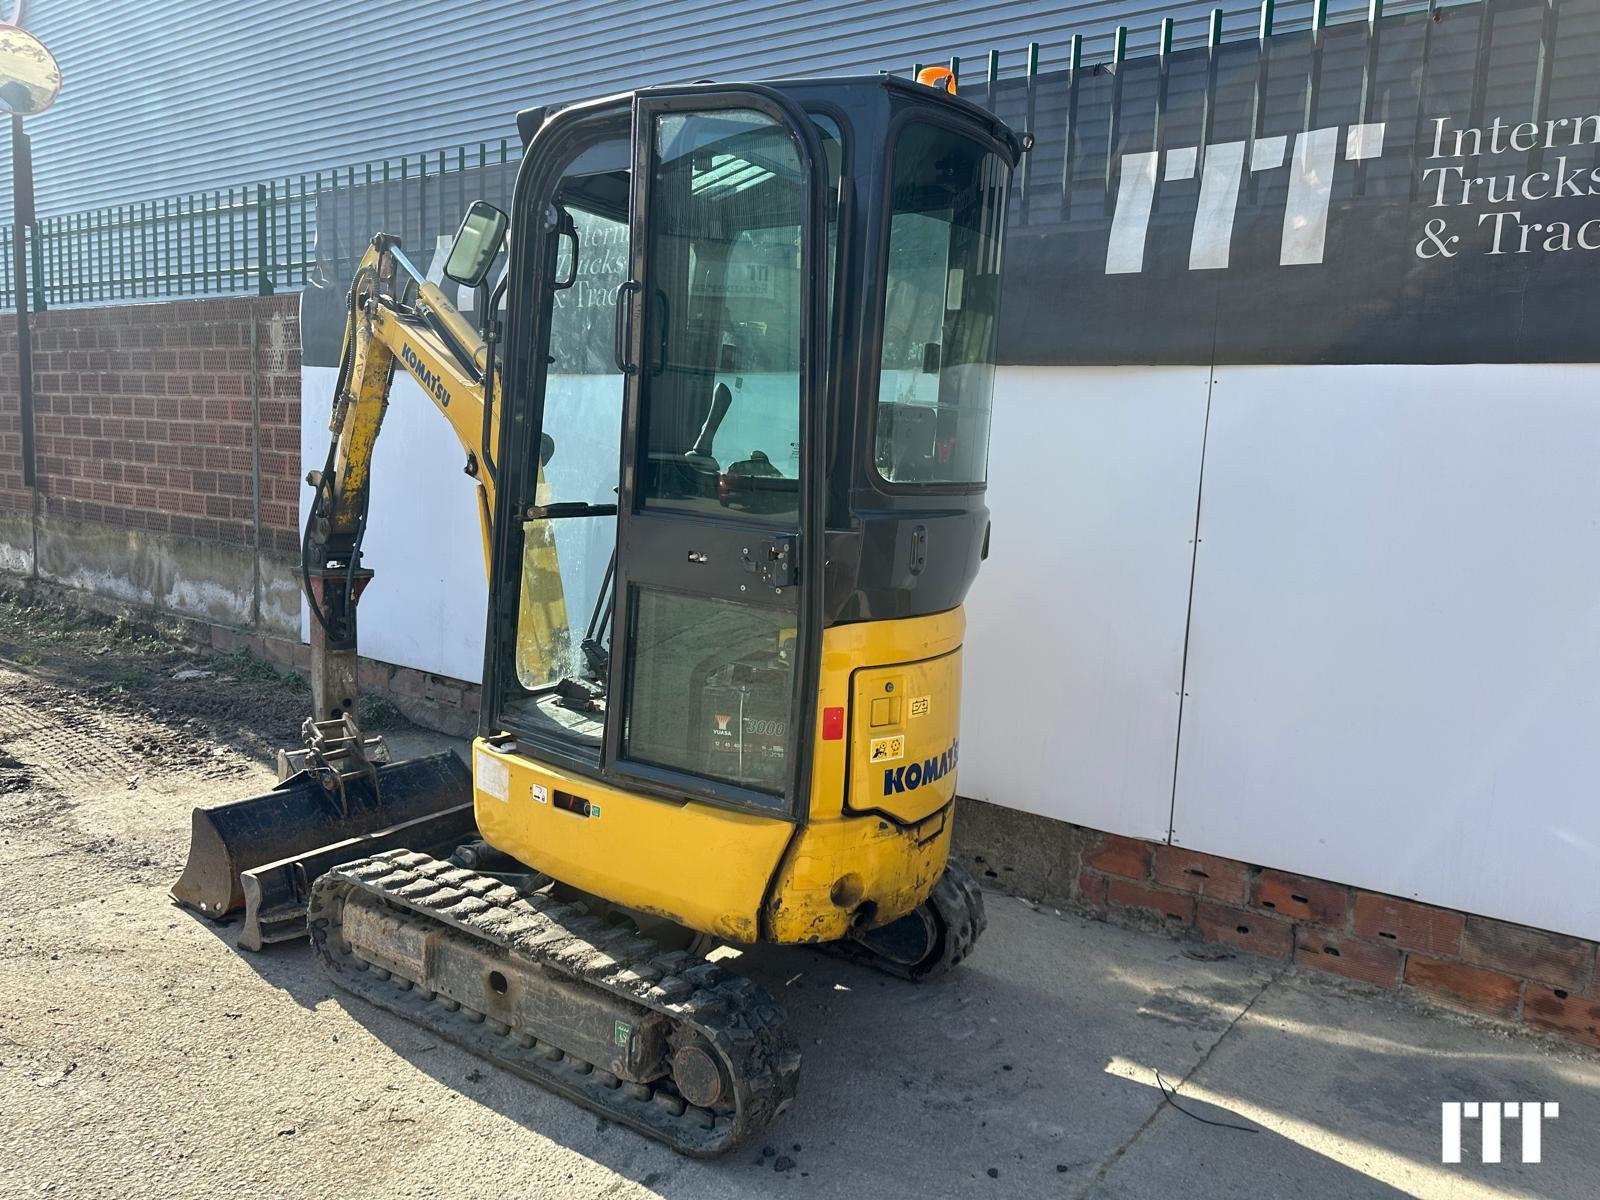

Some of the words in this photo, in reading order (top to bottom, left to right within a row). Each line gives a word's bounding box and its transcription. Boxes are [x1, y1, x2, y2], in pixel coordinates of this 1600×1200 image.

[1425, 115, 1600, 159] Intern
[1422, 156, 1600, 207] Trucks
[1415, 218, 1460, 259] &
[1477, 211, 1600, 255] Trac
[556, 249, 626, 276] Tucks
[401, 342, 451, 407] KOMATSU
[713, 729, 732, 737] YUASA
[746, 719, 785, 737] 3000
